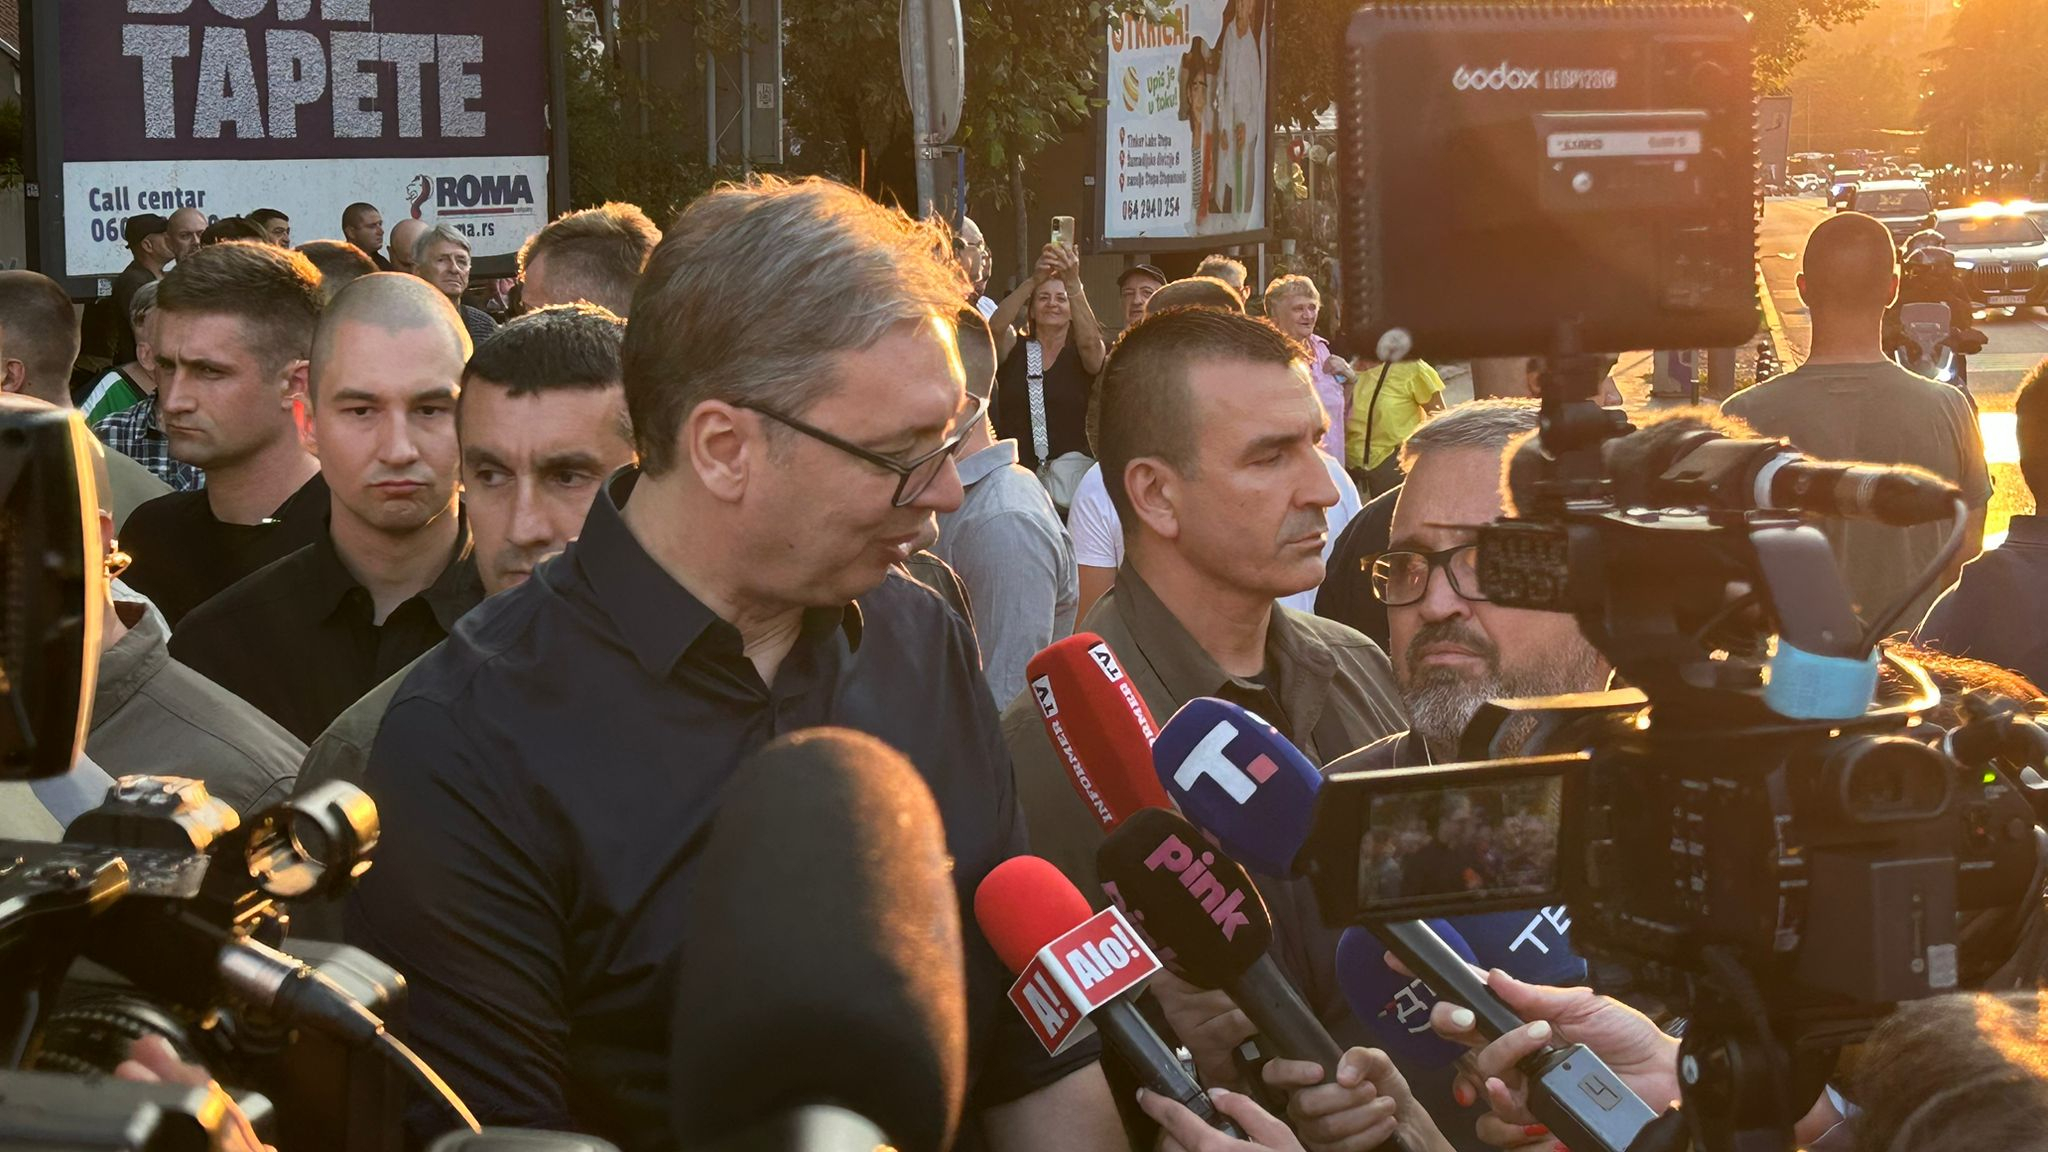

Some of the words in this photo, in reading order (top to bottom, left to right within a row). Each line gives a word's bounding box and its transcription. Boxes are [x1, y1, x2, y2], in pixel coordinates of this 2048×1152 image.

[122, 24, 487, 139] TAPETE
[1166, 65, 1175, 89] je
[1452, 61, 1539, 90] Godox
[1156, 87, 1178, 112] toku!
[89, 186, 130, 212] Call
[138, 187, 206, 210] centar
[436, 174, 534, 207] ROMA
[1122, 200, 1139, 220] 064
[1164, 196, 1180, 216] 254
[1034, 685, 1055, 716] TV
[1119, 682, 1156, 748] RMER
[1052, 719, 1113, 823] INFORMER
[1022, 970, 1070, 1039] A!
